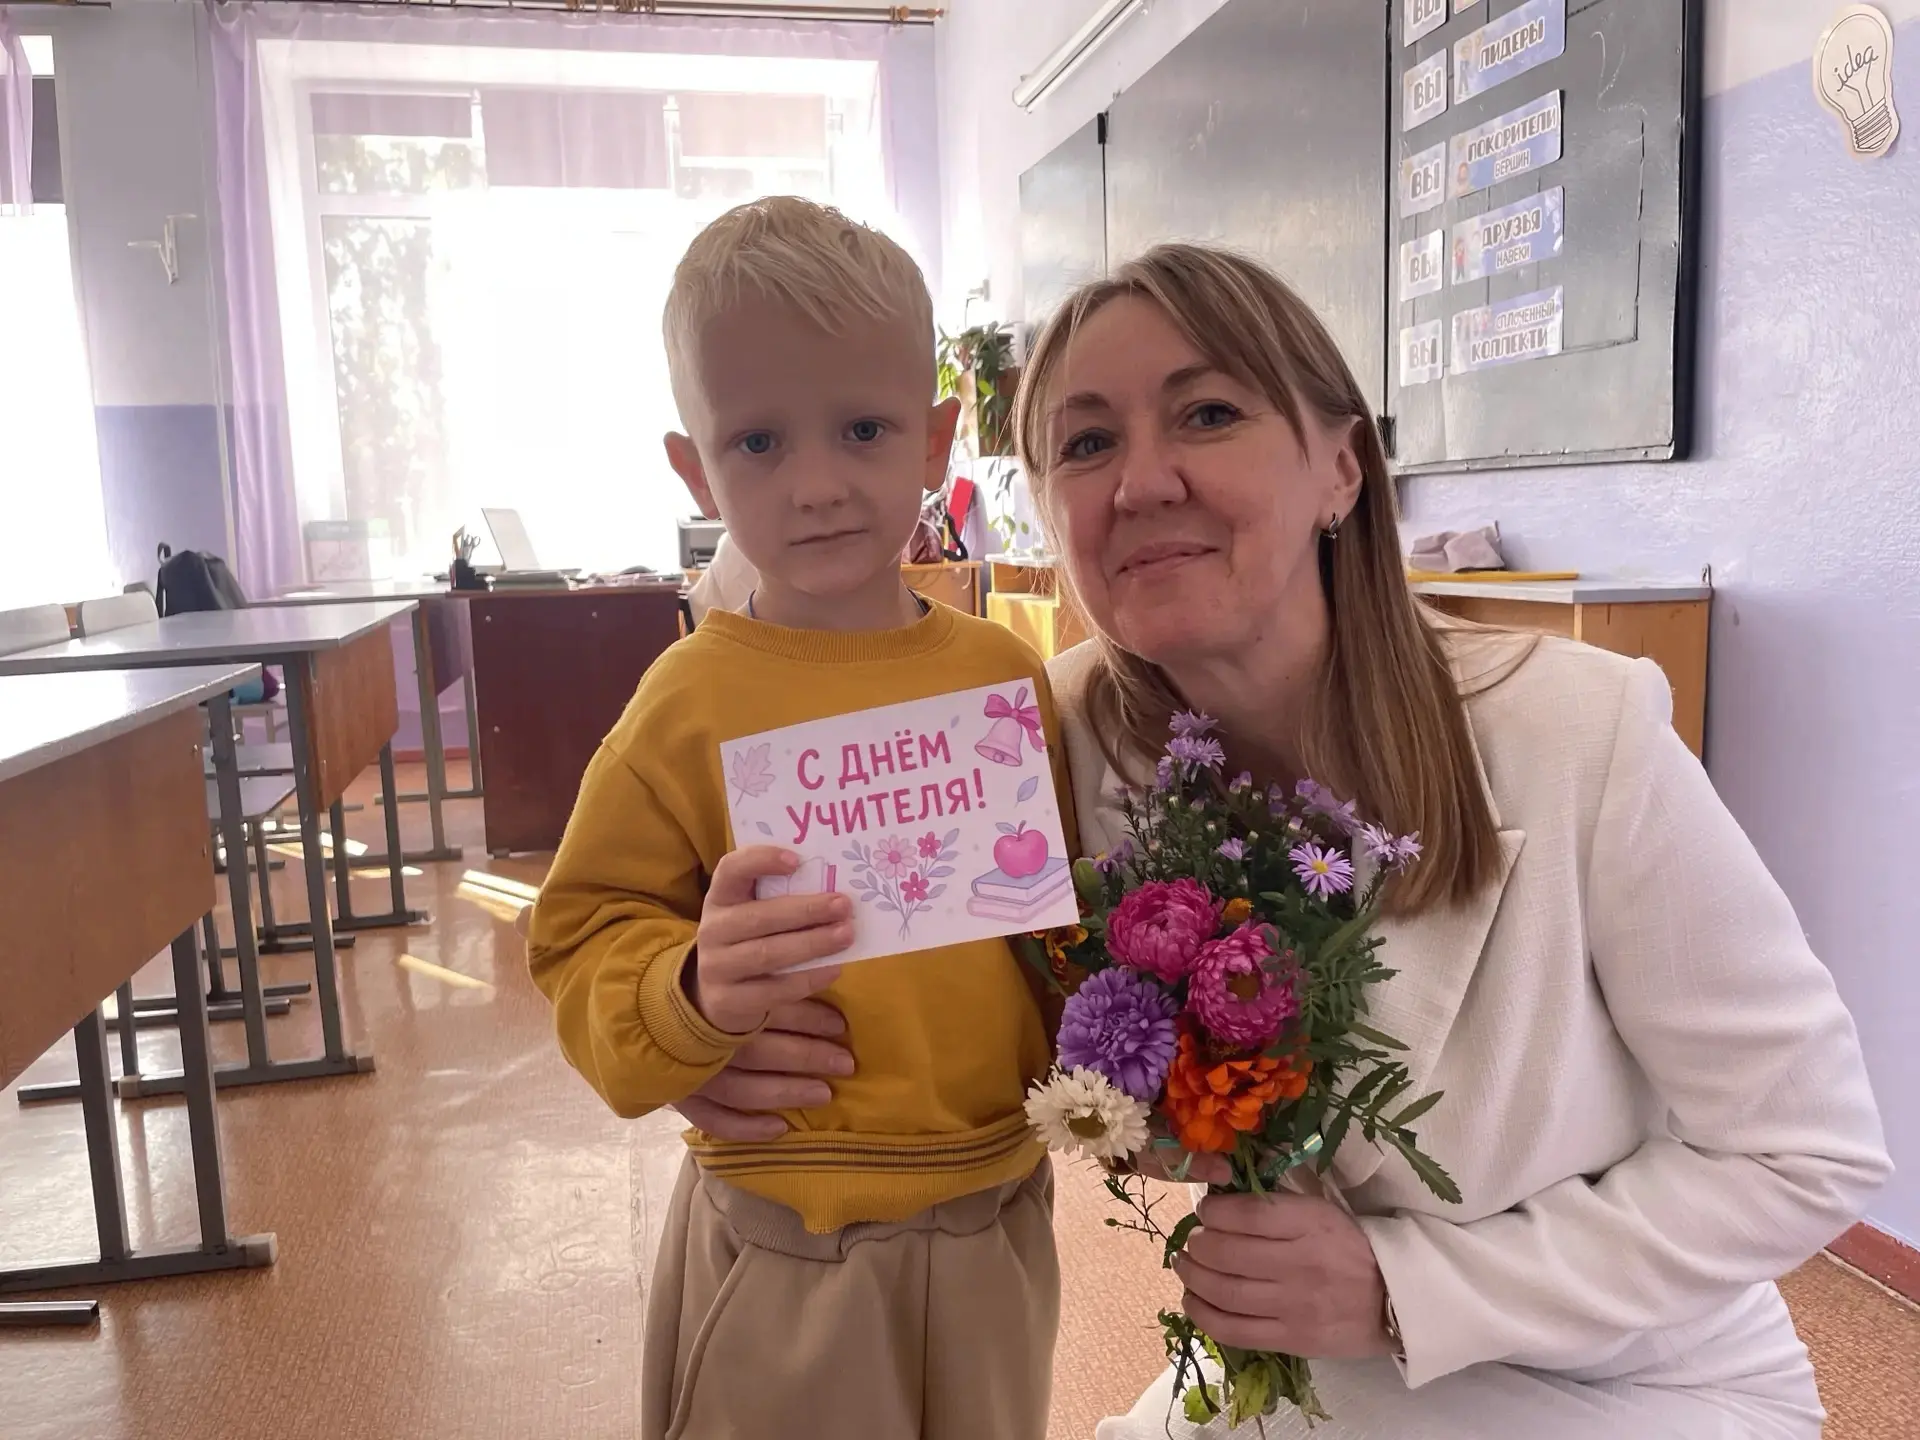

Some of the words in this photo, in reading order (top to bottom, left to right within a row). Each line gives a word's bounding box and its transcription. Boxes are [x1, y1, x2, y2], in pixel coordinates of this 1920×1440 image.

[1479, 17, 1544, 71] ЛИДЕРЫ
[1834, 44, 1879, 92] idea
[1413, 68, 1442, 111] ВЫ
[1467, 107, 1557, 161] ПОКОРИТЕЛИ
[1411, 160, 1441, 200] ВЫ
[1495, 150, 1529, 177] ВЕРШИН
[1482, 208, 1541, 248] ДРУЗЬЯ
[1409, 251, 1438, 284] ВЫ
[1496, 244, 1530, 268] НАВЕКИ
[1408, 337, 1437, 369] ВЫ
[1471, 325, 1556, 362] КОЛЛЕКТИ
[797, 749, 825, 790] С
[838, 729, 952, 790] ДНЁМ
[786, 768, 986, 845] УЧИТЕЛЯ!
